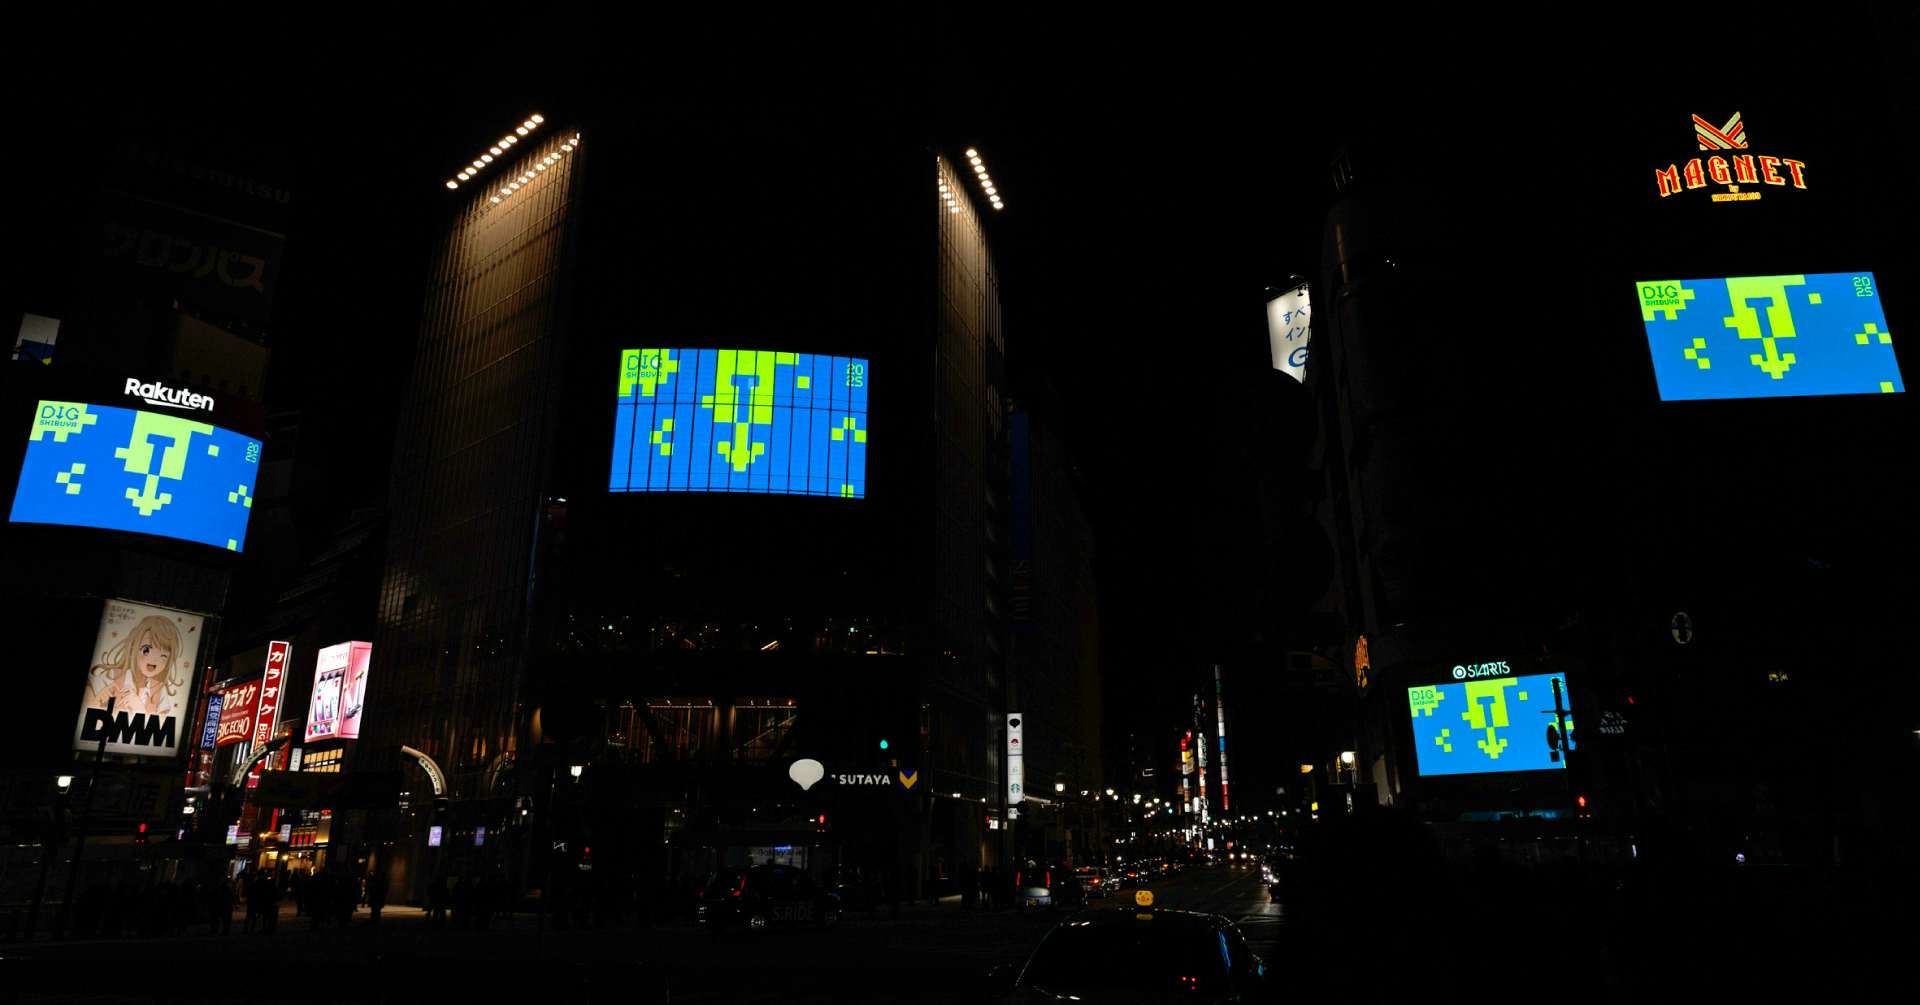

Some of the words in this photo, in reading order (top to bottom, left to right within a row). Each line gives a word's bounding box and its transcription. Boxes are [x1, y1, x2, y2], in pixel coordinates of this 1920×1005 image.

[1656, 155, 1807, 197] MAGNET
[1642, 285, 1678, 299] DIG
[1283, 304, 1311, 325] すべ
[627, 354, 662, 370] DIG
[124, 378, 214, 411] Rakuten
[41, 405, 79, 421] DIG
[40, 419, 77, 427] SHIBUYA
[261, 650, 284, 715] カラオケ
[223, 684, 257, 711] カラオケ
[1411, 689, 1434, 701] DIG
[80, 707, 176, 748] DMM
[831, 774, 890, 785] SUTAYA
